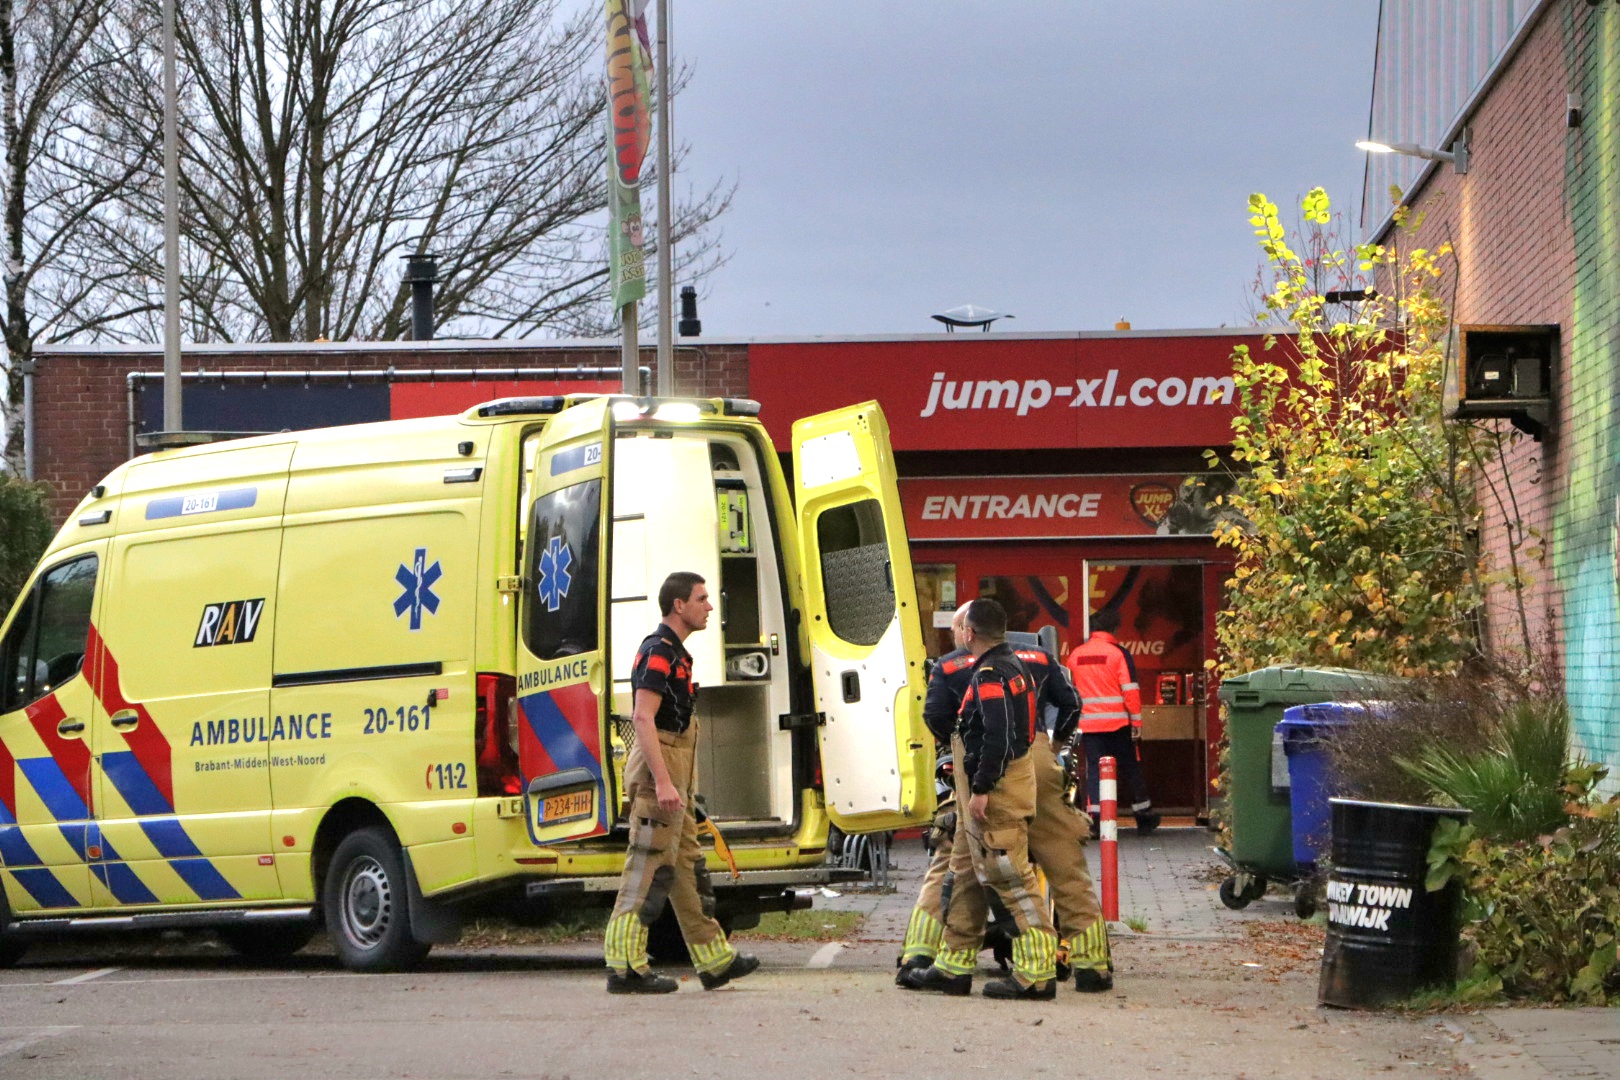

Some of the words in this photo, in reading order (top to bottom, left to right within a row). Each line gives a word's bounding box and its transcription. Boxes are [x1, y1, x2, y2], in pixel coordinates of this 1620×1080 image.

[920, 369, 1235, 418] jump-xl.com
[185, 496, 215, 512] 20-161
[921, 493, 1102, 519] ENTRANCE
[1135, 493, 1173, 504] JUMP
[195, 600, 264, 645] RAV
[518, 659, 588, 692] AMBULANCE
[190, 712, 332, 747] AMBULANCE
[363, 705, 431, 735] 20-161
[1358, 884, 1412, 909] TOWN
